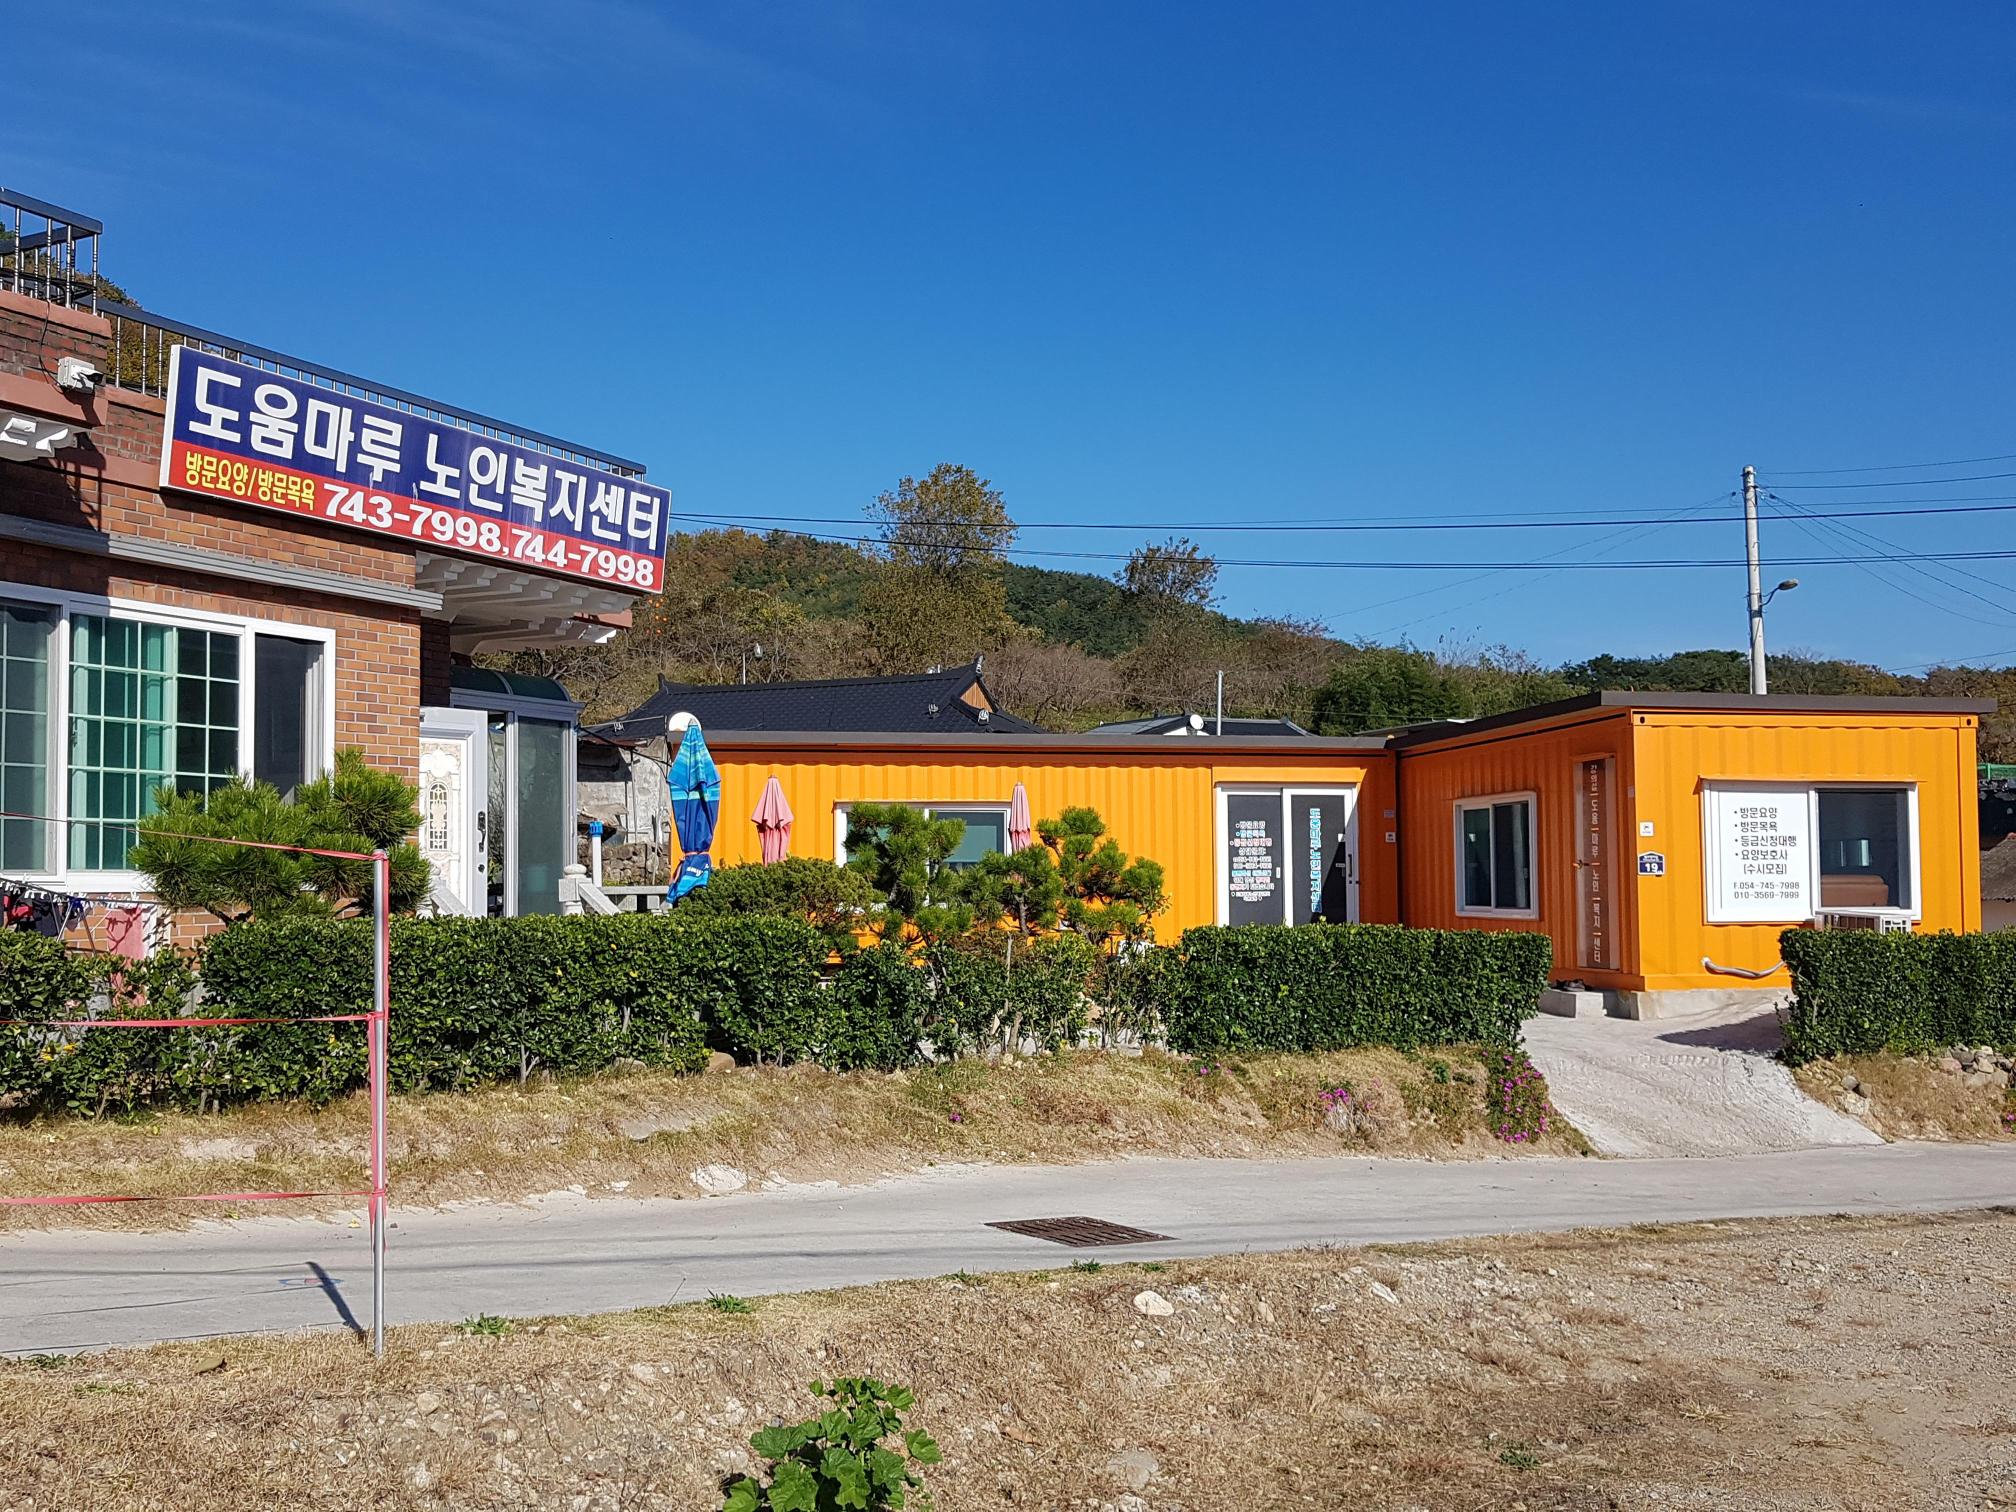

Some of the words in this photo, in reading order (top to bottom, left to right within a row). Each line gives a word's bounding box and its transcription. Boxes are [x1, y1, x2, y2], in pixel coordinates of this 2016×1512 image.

[188, 365, 404, 483] 도움마루
[419, 433, 661, 551] 노인복지센터
[185, 451, 315, 511] 방문요양/방문목욕
[1740, 807, 1777, 819] 방문요양
[1740, 821, 1778, 833] 방문목욕
[1644, 862, 1659, 873] 19
